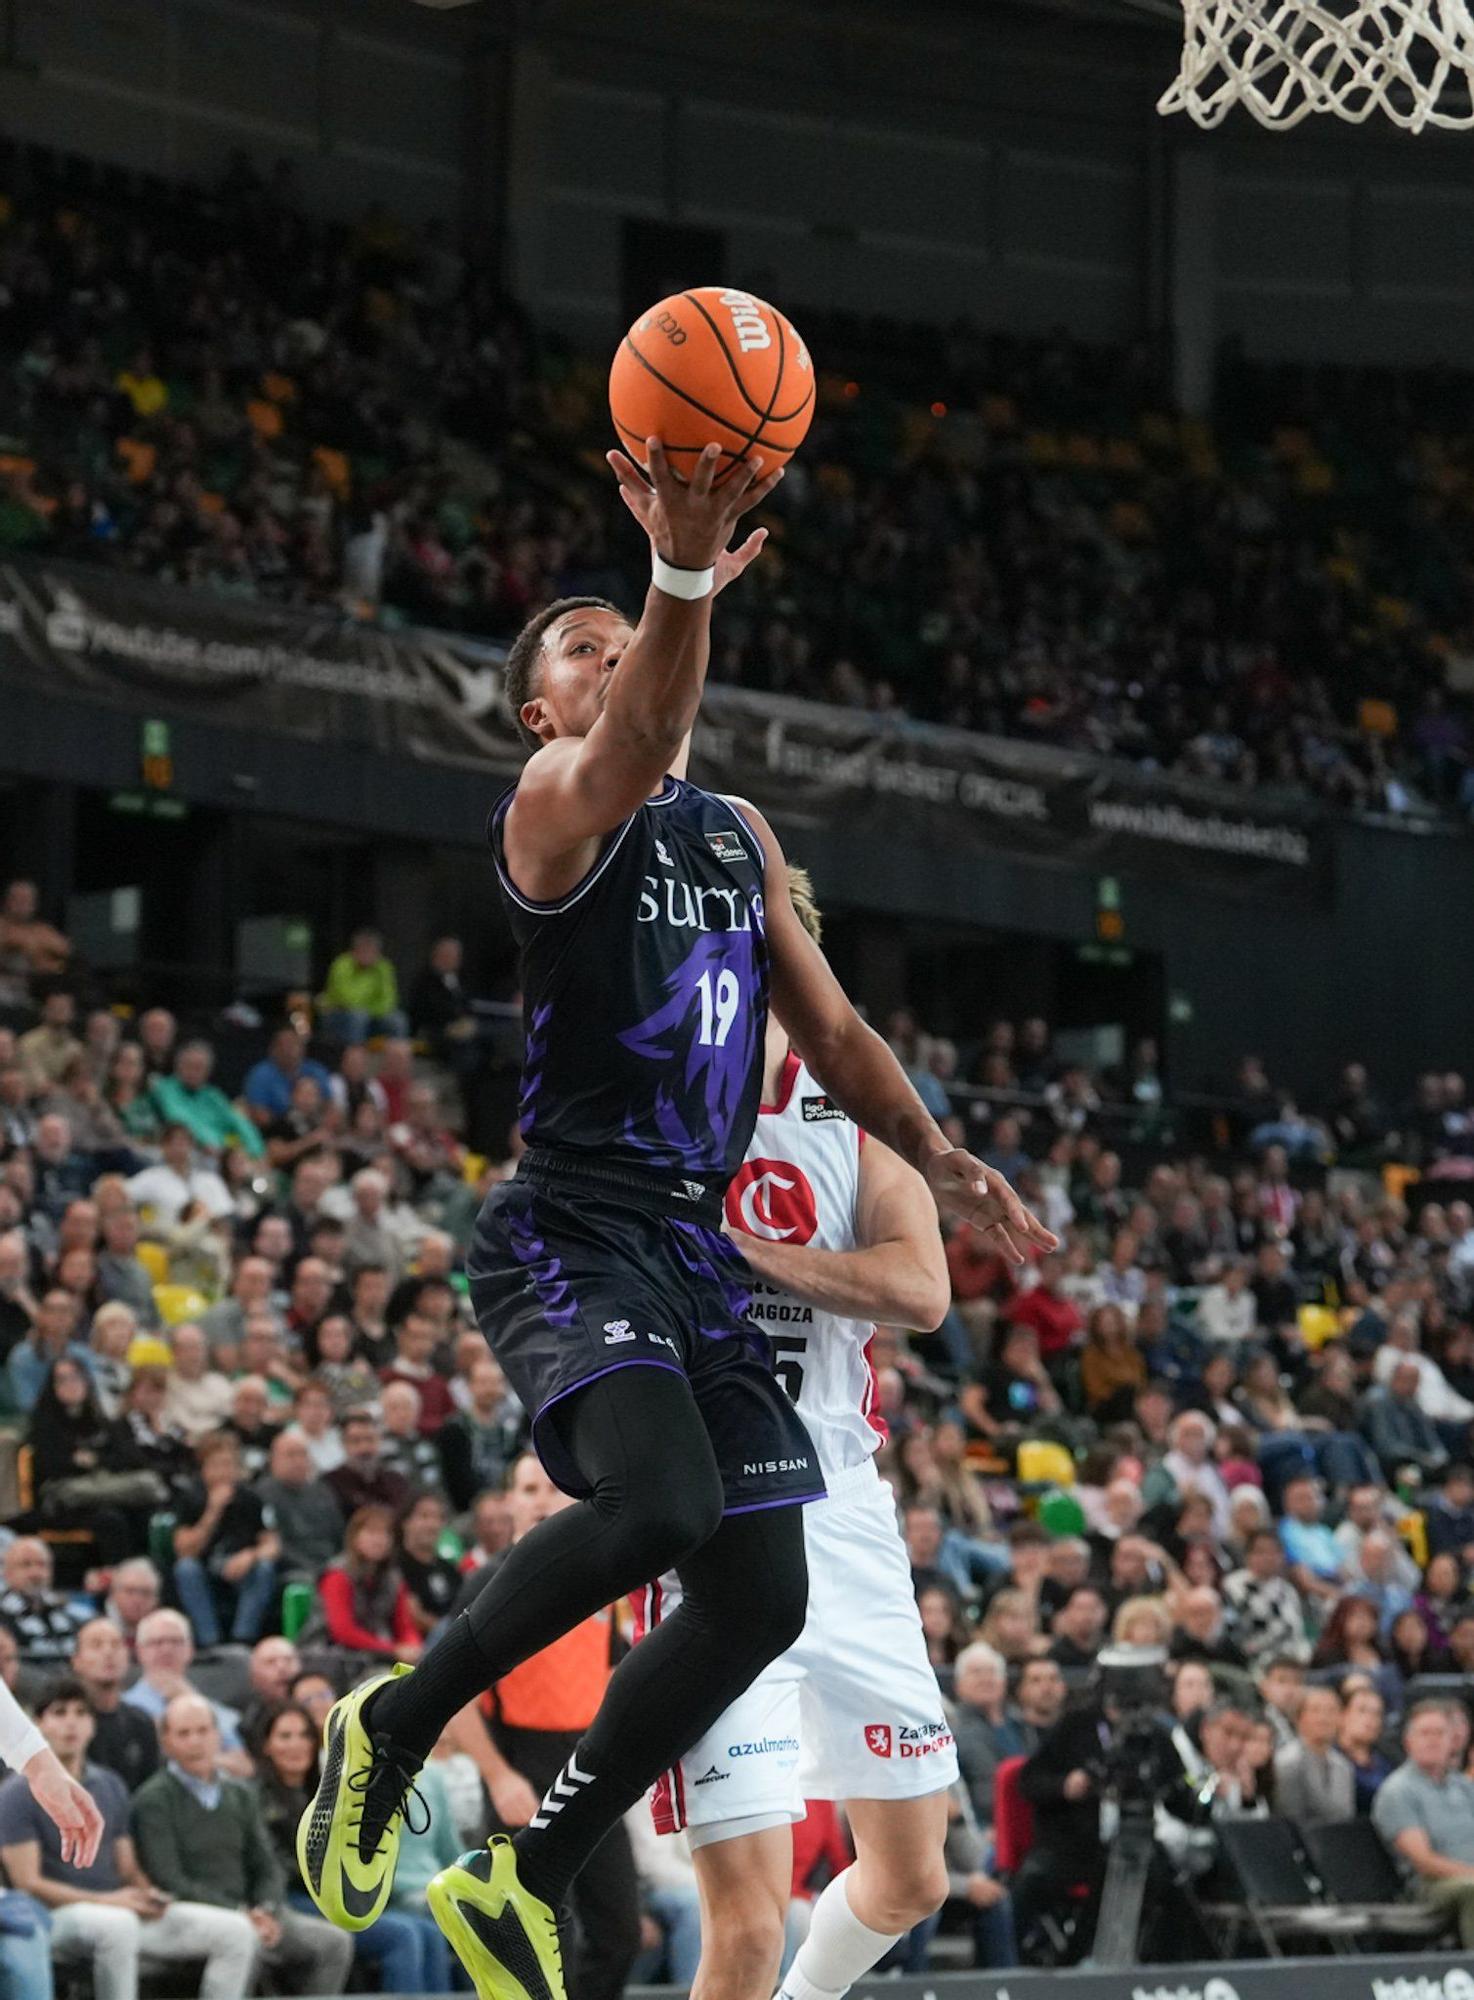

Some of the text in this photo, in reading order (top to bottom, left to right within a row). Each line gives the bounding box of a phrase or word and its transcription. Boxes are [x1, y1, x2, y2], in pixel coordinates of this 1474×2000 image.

[695, 968, 739, 1047] 19
[745, 1302, 813, 1323] RAGOZA
[743, 1457, 808, 1475] NISSAN
